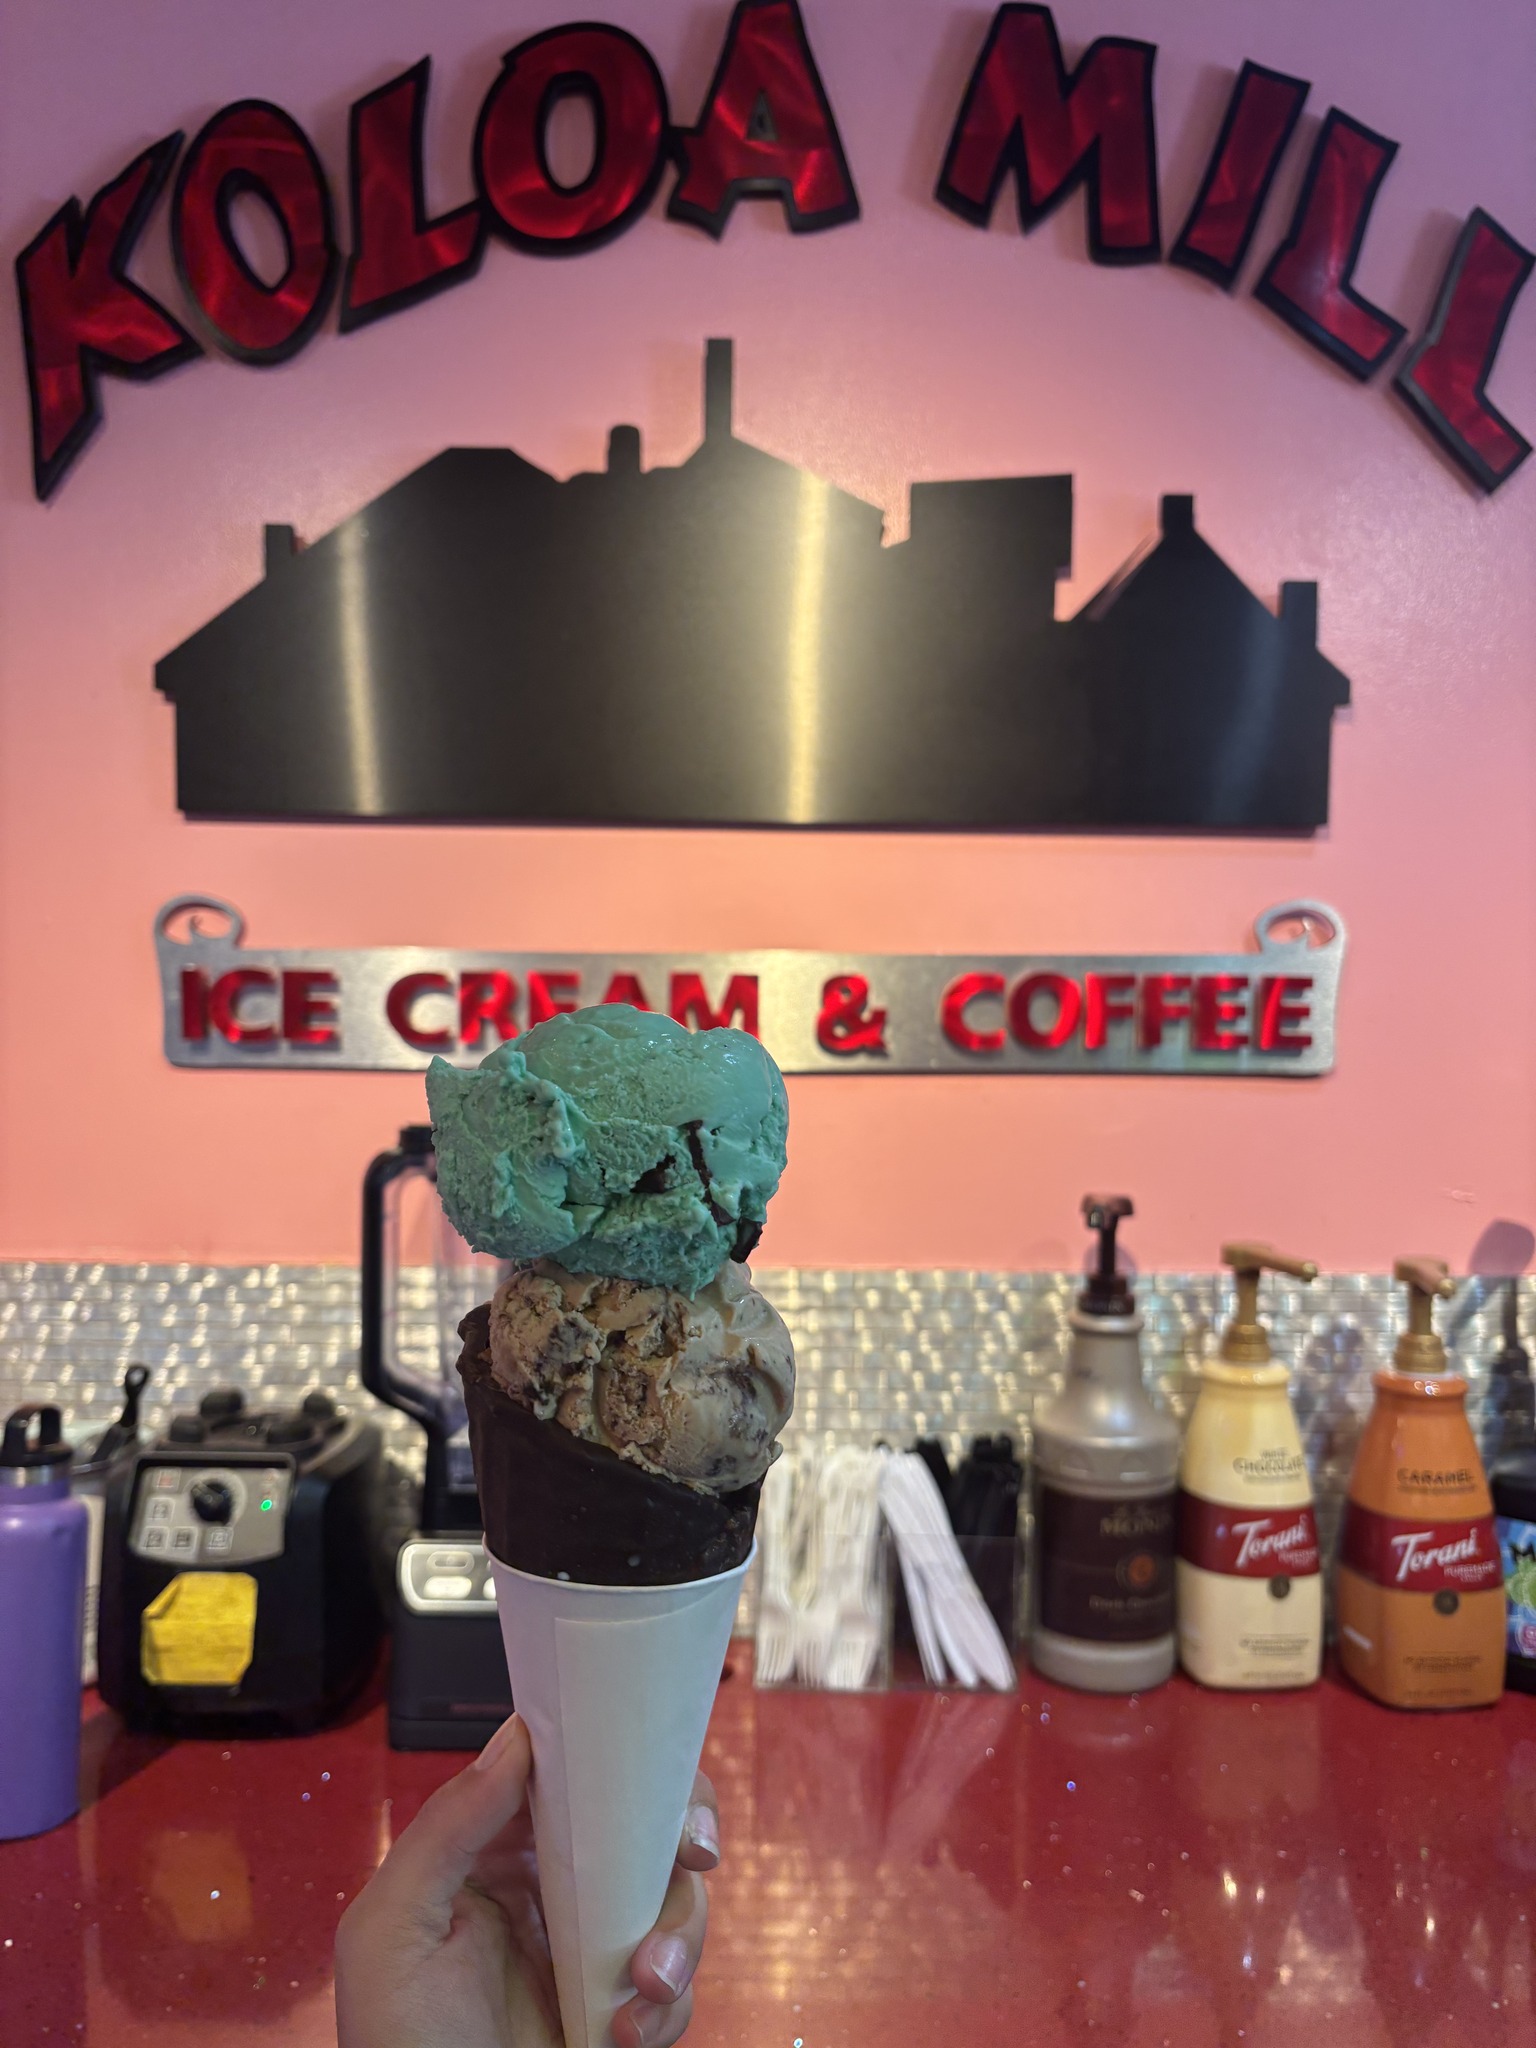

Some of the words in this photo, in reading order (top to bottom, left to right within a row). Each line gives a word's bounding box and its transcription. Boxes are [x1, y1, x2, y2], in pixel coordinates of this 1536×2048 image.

[15, 0, 860, 503] KOLOA
[933, 2, 1535, 496] MILL
[180, 966, 338, 1046] ICE
[815, 973, 887, 1054] &
[940, 971, 1314, 1053] COFFEE
[1230, 1513, 1308, 1568] Torani
[1390, 1526, 1479, 1582] Torani
